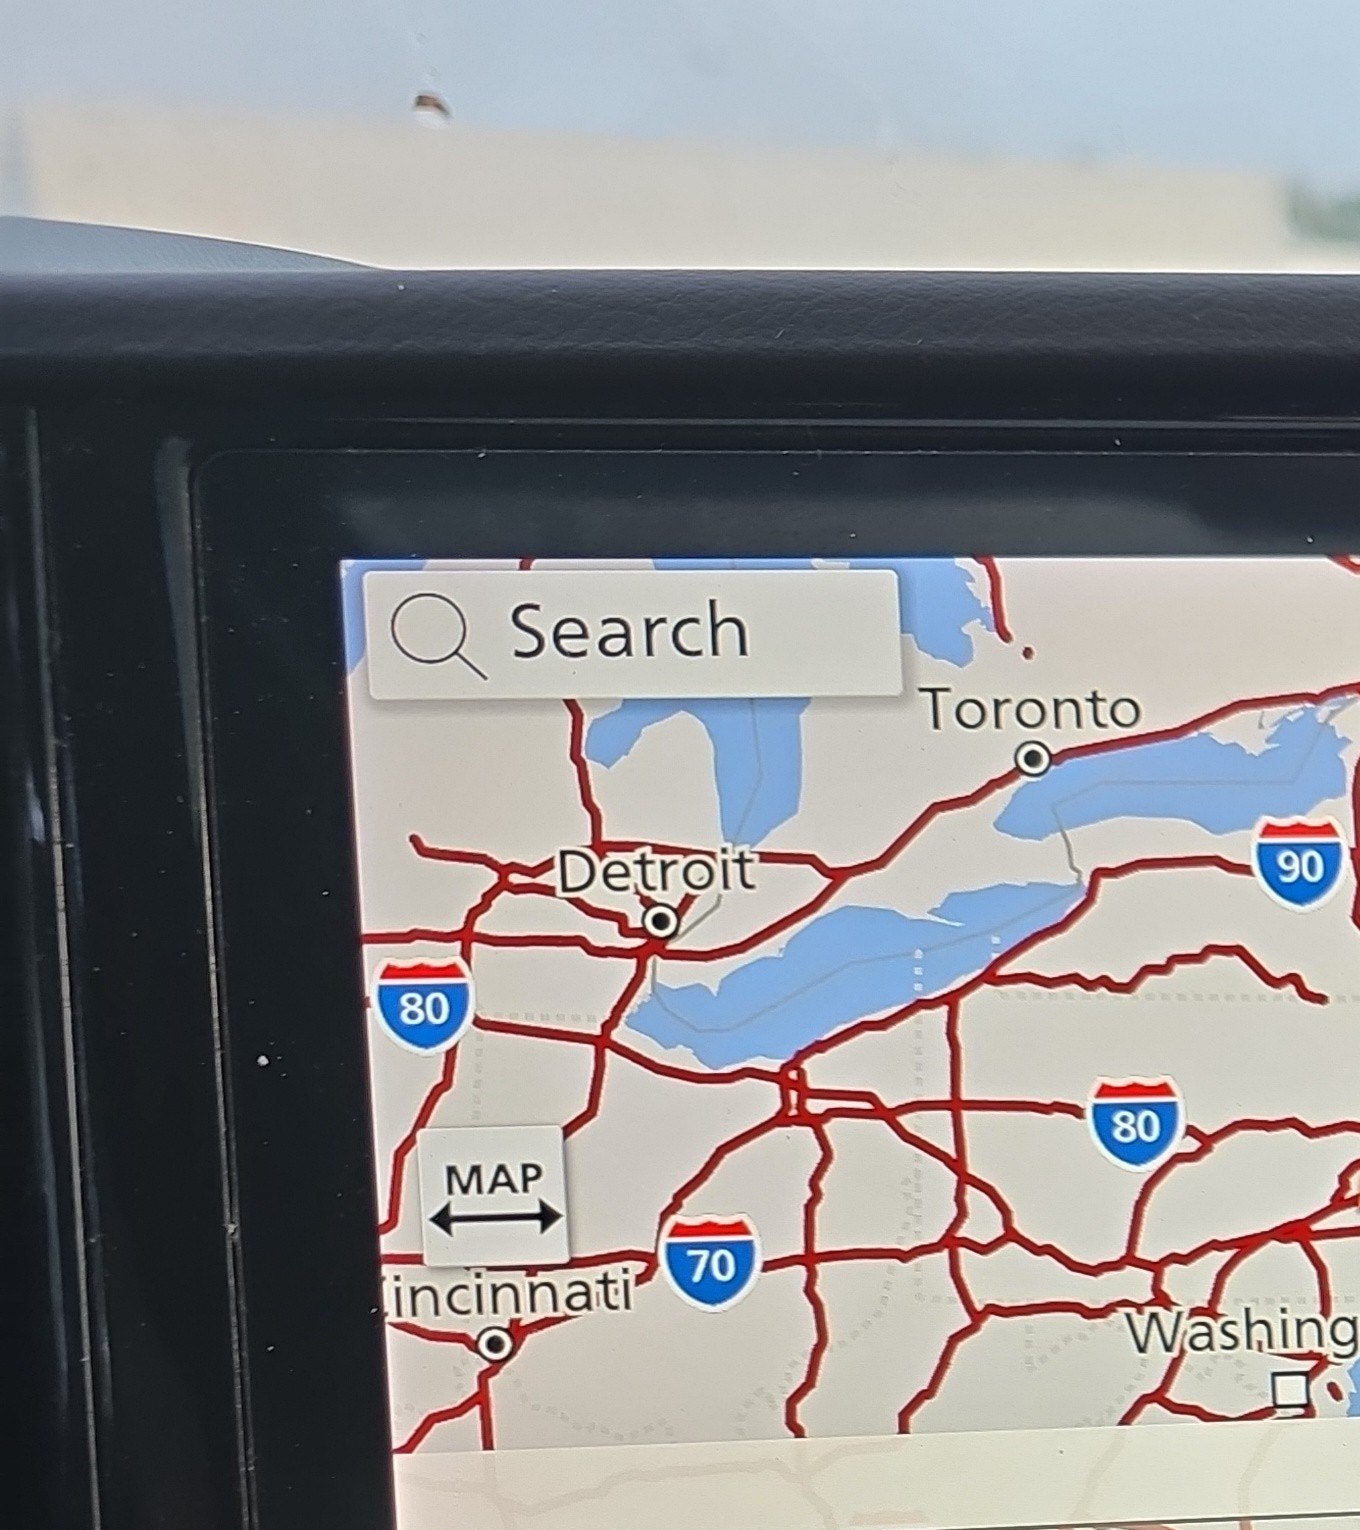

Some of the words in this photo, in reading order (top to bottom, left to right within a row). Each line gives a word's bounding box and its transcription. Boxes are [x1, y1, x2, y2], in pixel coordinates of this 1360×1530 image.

[512, 600, 748, 659] Search
[919, 686, 1142, 731] Toronto
[559, 847, 755, 893] Detroit
[1276, 849, 1324, 883] 90
[400, 992, 450, 1027] 80
[1111, 1110, 1160, 1144] 80
[445, 1164, 544, 1197] MAP
[686, 1249, 736, 1284] 70
[382, 1267, 633, 1319] incinnati
